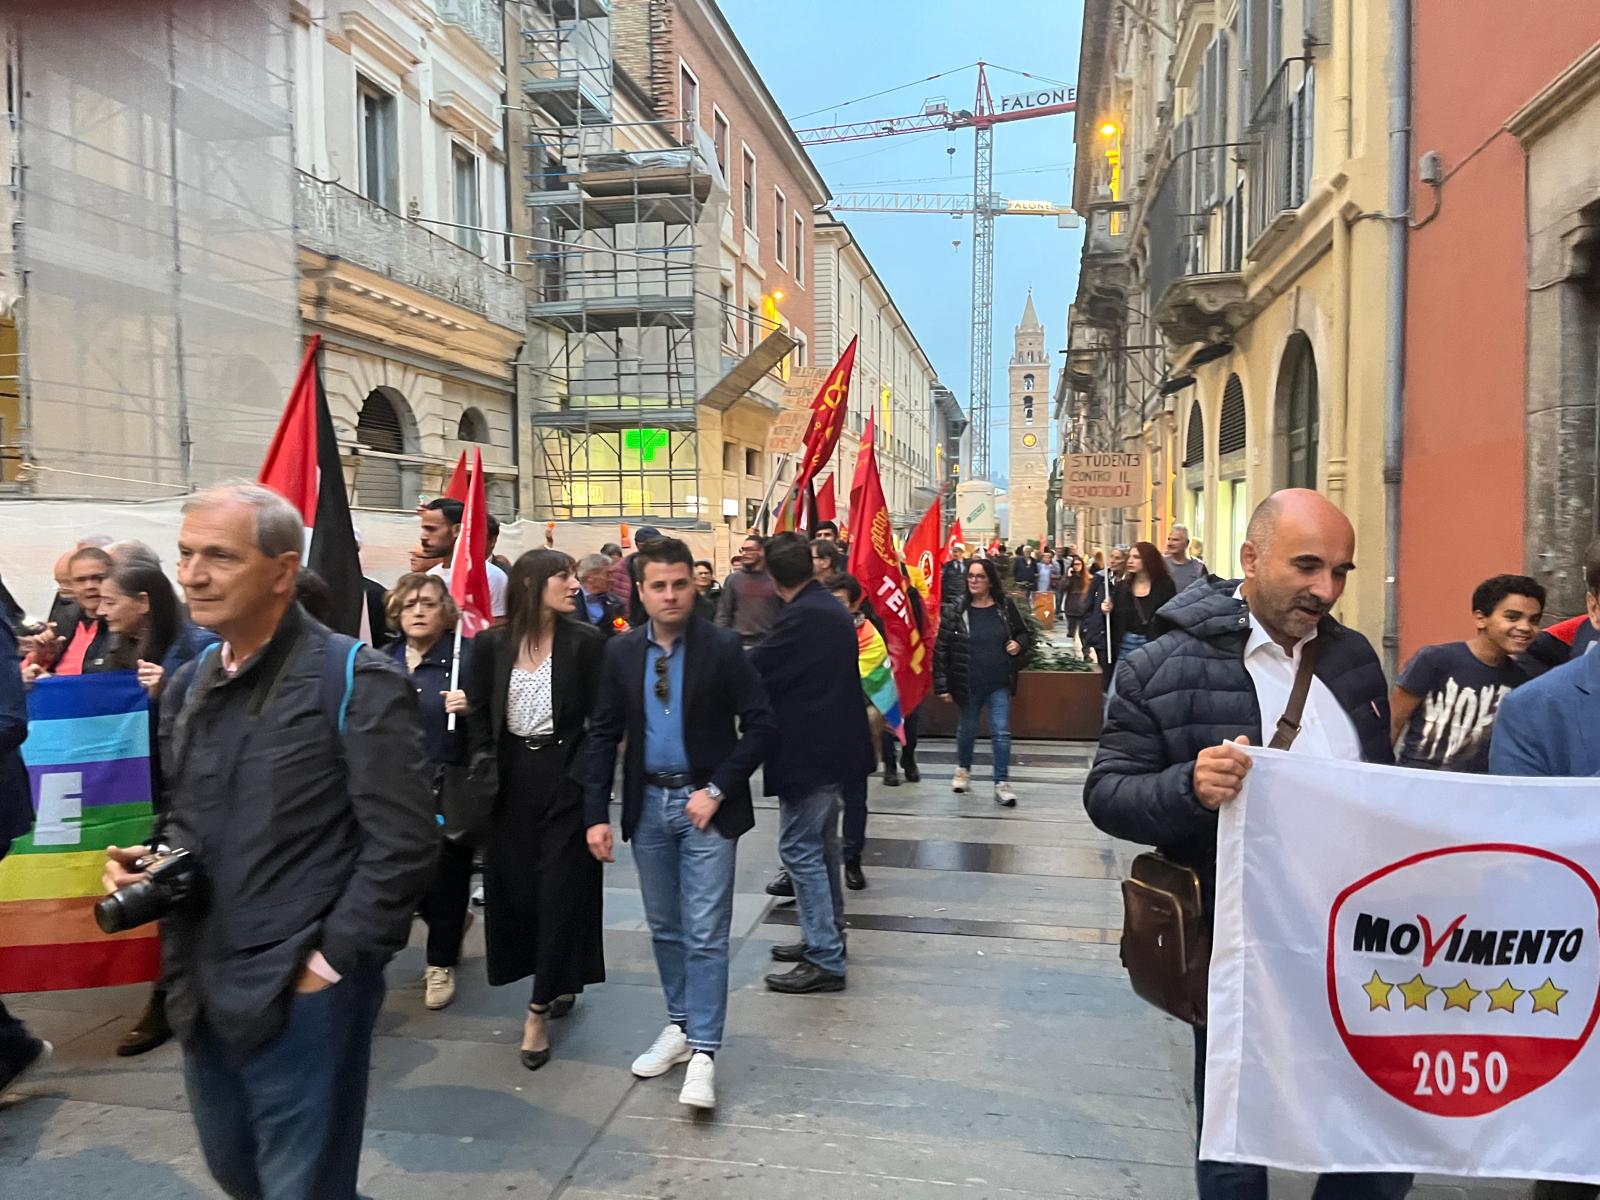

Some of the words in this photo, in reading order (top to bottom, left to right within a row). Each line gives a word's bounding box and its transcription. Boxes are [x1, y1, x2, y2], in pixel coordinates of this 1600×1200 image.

[1002, 88, 1076, 111] FALONE
[1008, 201, 1052, 210] FALONE
[1071, 471, 1110, 482] CONTRO
[1120, 471, 1132, 483] IL
[1353, 913, 1583, 968] MOVIMENTO
[1413, 1050, 1508, 1096] 2050
